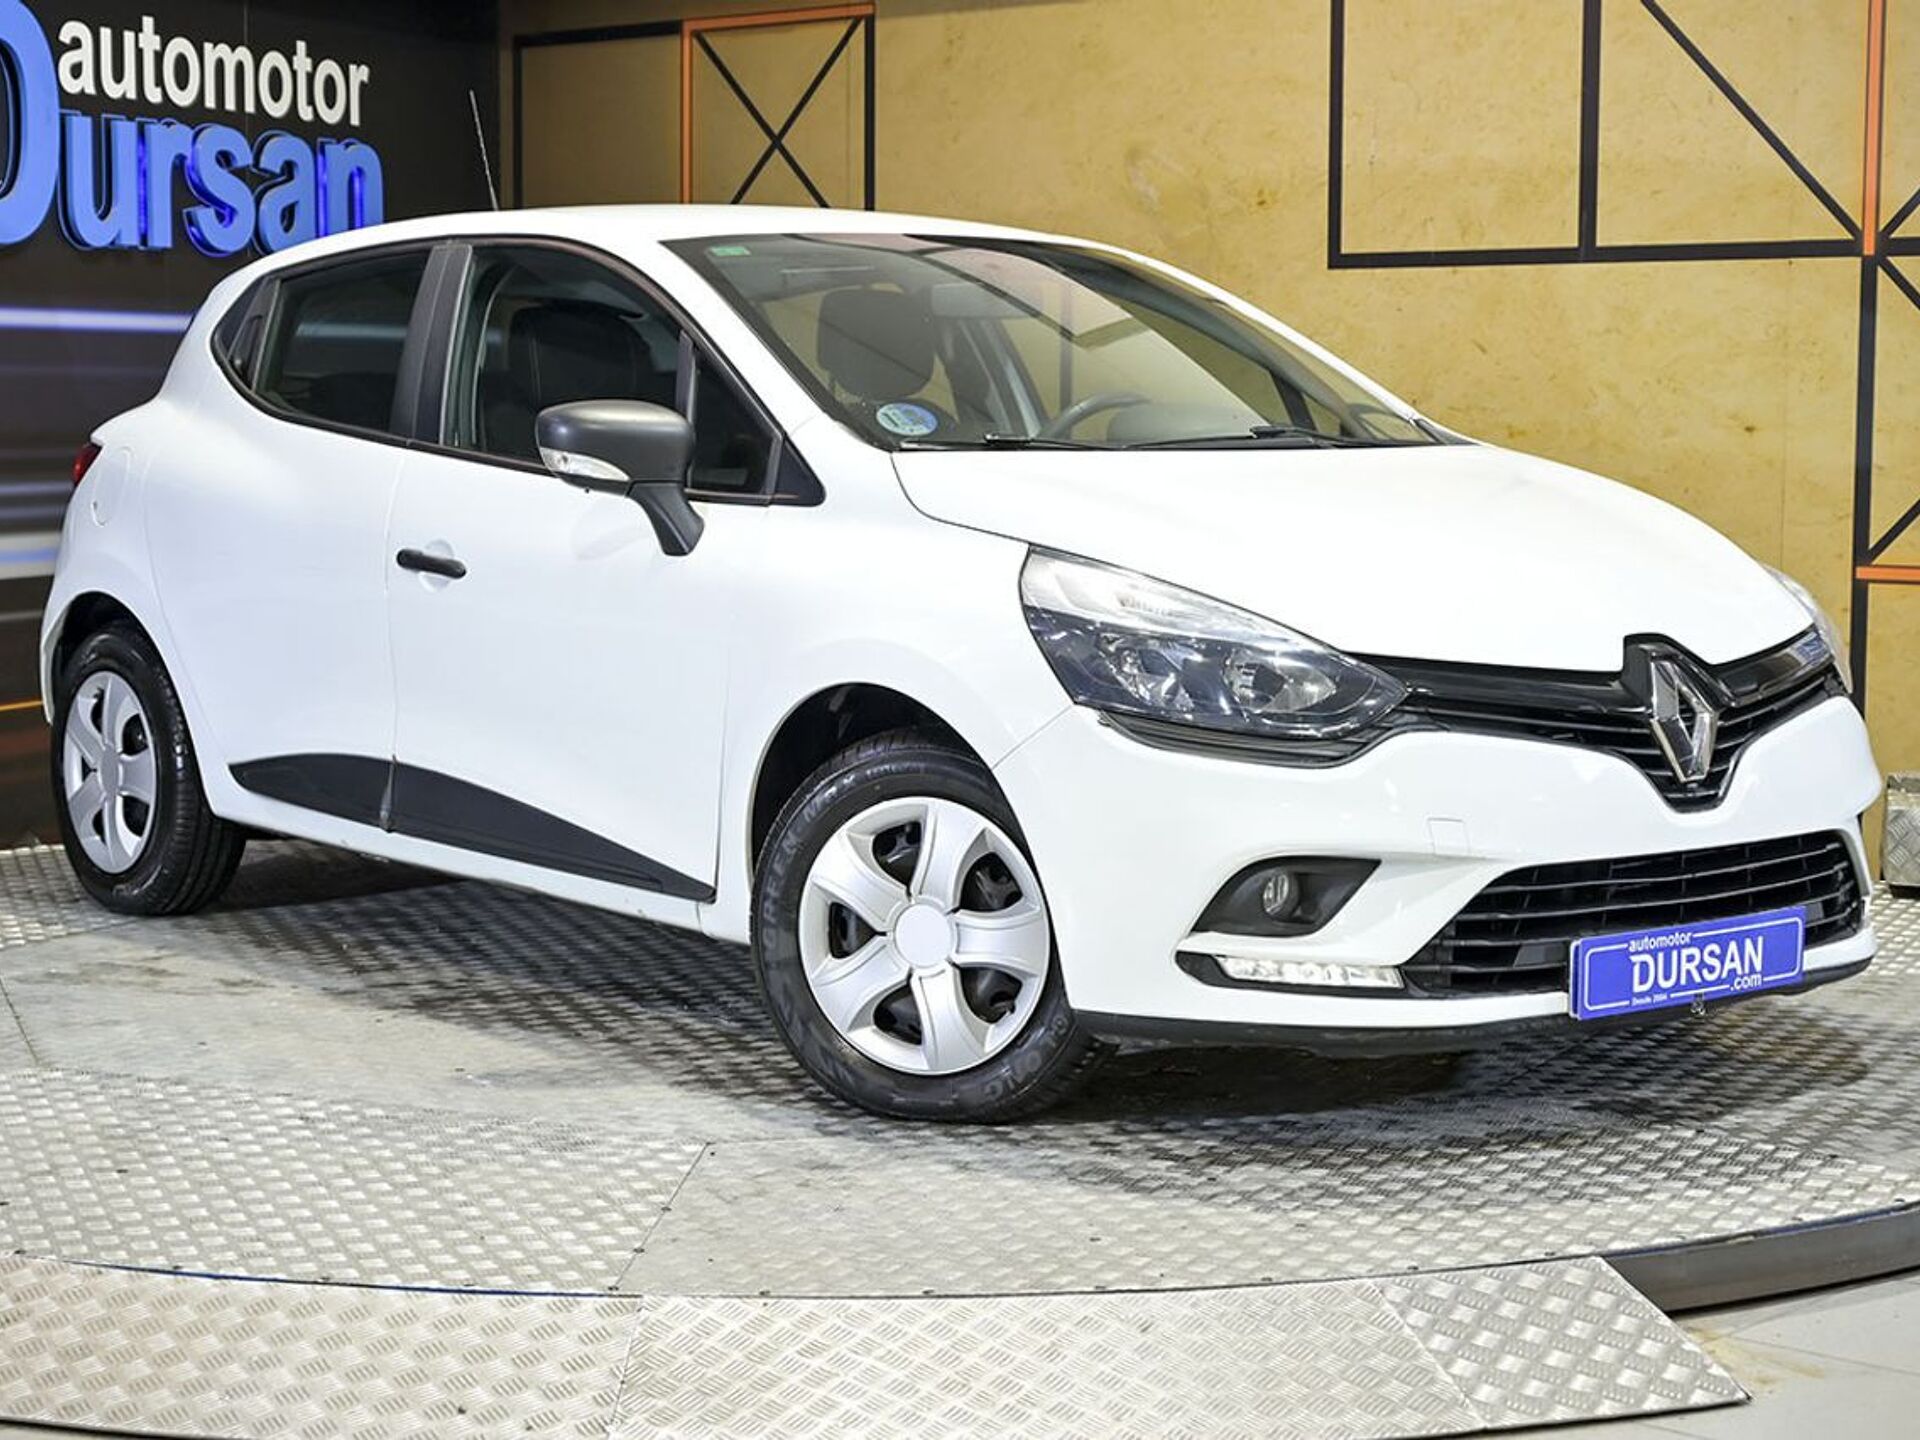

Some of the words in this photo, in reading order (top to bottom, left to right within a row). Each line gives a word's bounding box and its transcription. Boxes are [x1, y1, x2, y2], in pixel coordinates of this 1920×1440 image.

[58, 15, 369, 127] automotor
[1628, 932, 1692, 952] automotor
[1629, 936, 1763, 993] DURSAN
[1730, 974, 1762, 991] .com
